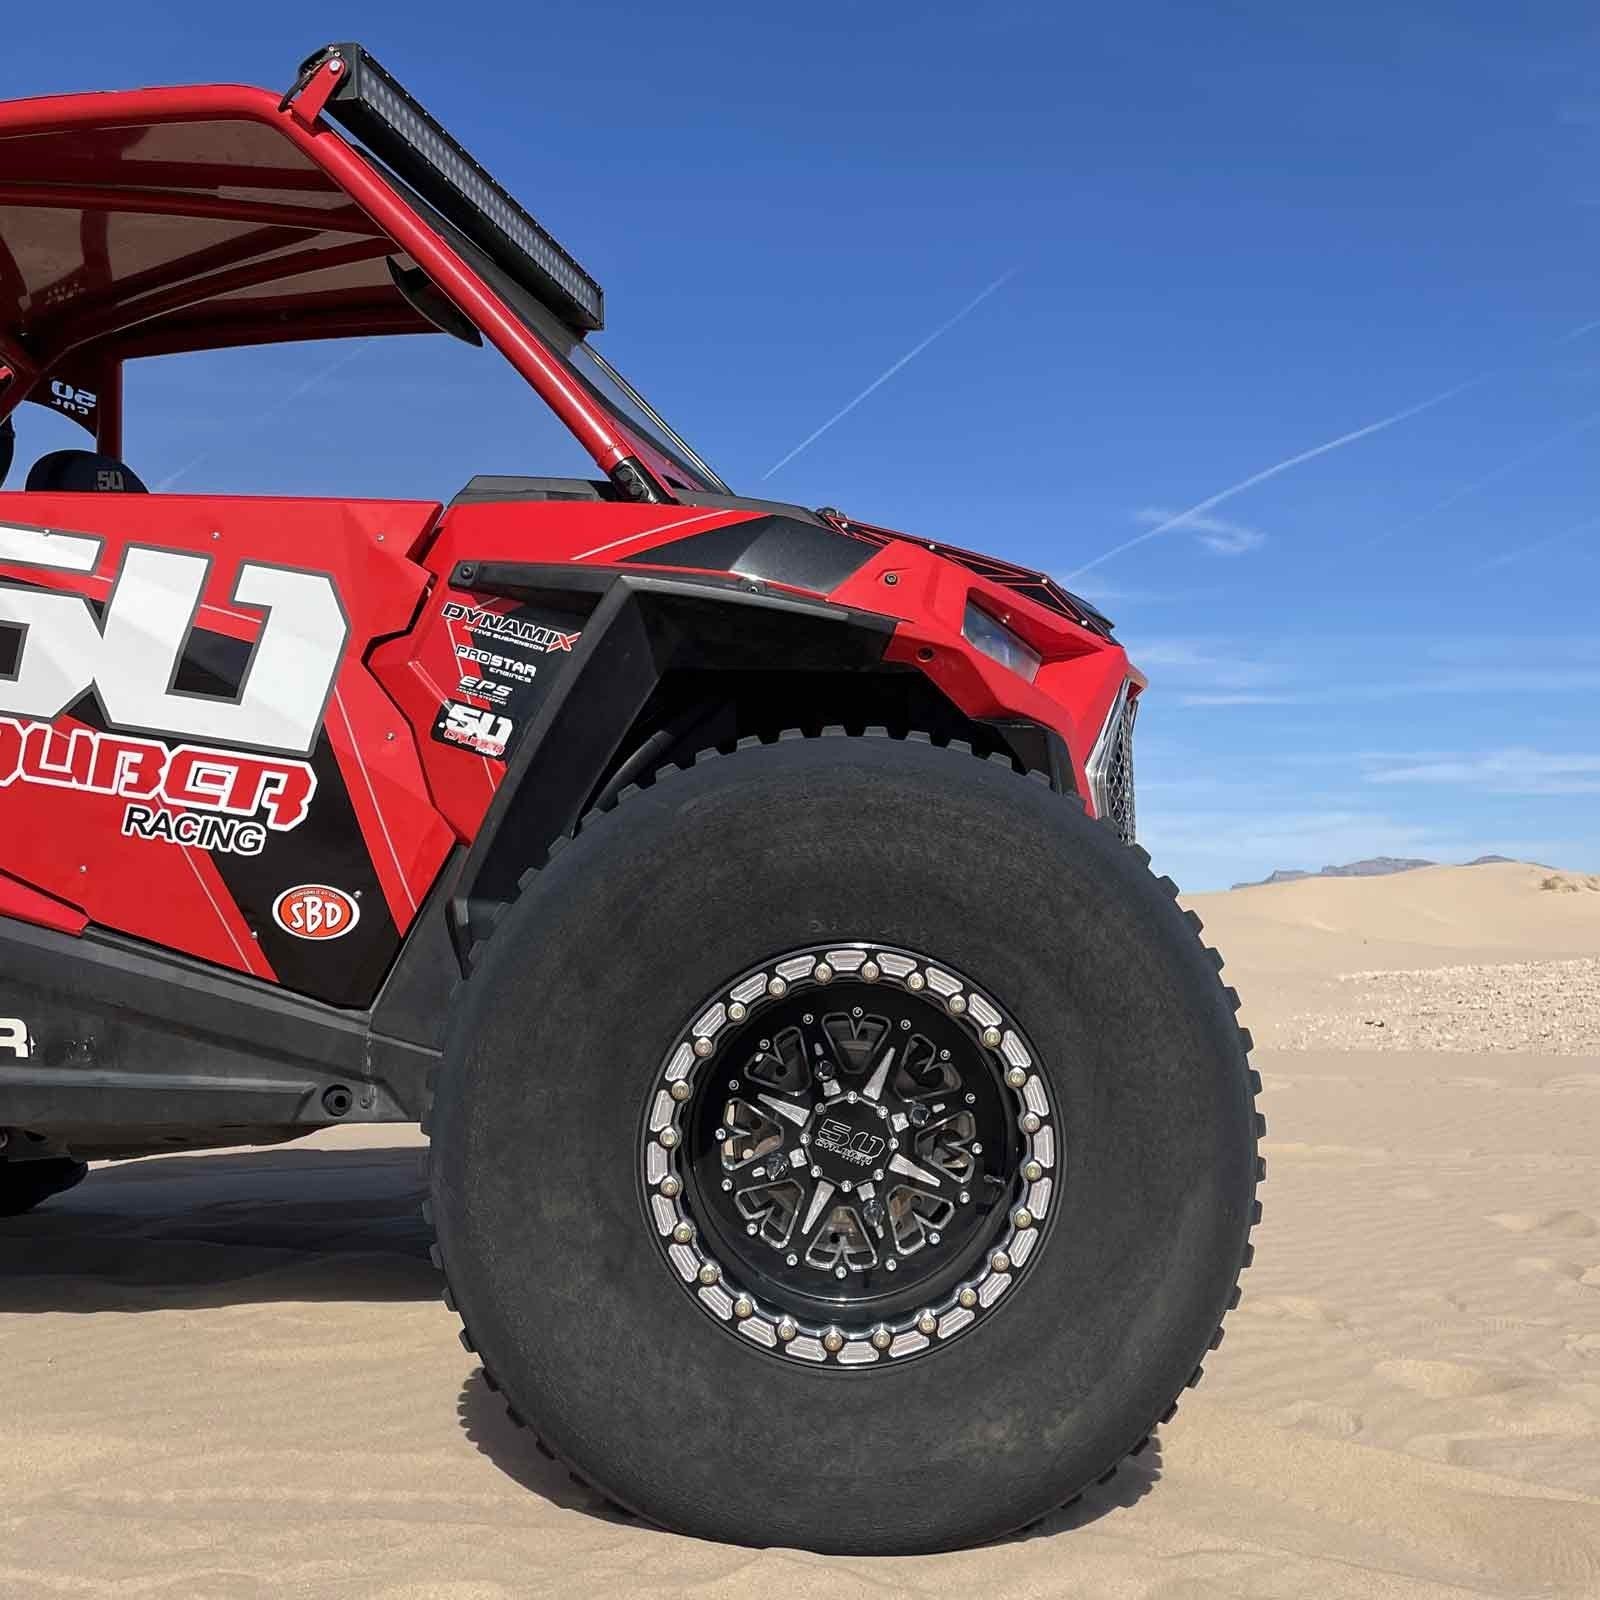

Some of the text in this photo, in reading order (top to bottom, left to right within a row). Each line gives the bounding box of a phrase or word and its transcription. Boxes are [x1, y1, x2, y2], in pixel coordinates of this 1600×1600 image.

[441, 602, 582, 653] DYNAMIX
[493, 633, 545, 652] SUSPENSION
[456, 643, 537, 677] PROSTAR
[460, 676, 513, 697] EPS
[121, 804, 268, 856] RACING
[290, 896, 343, 934] SBD
